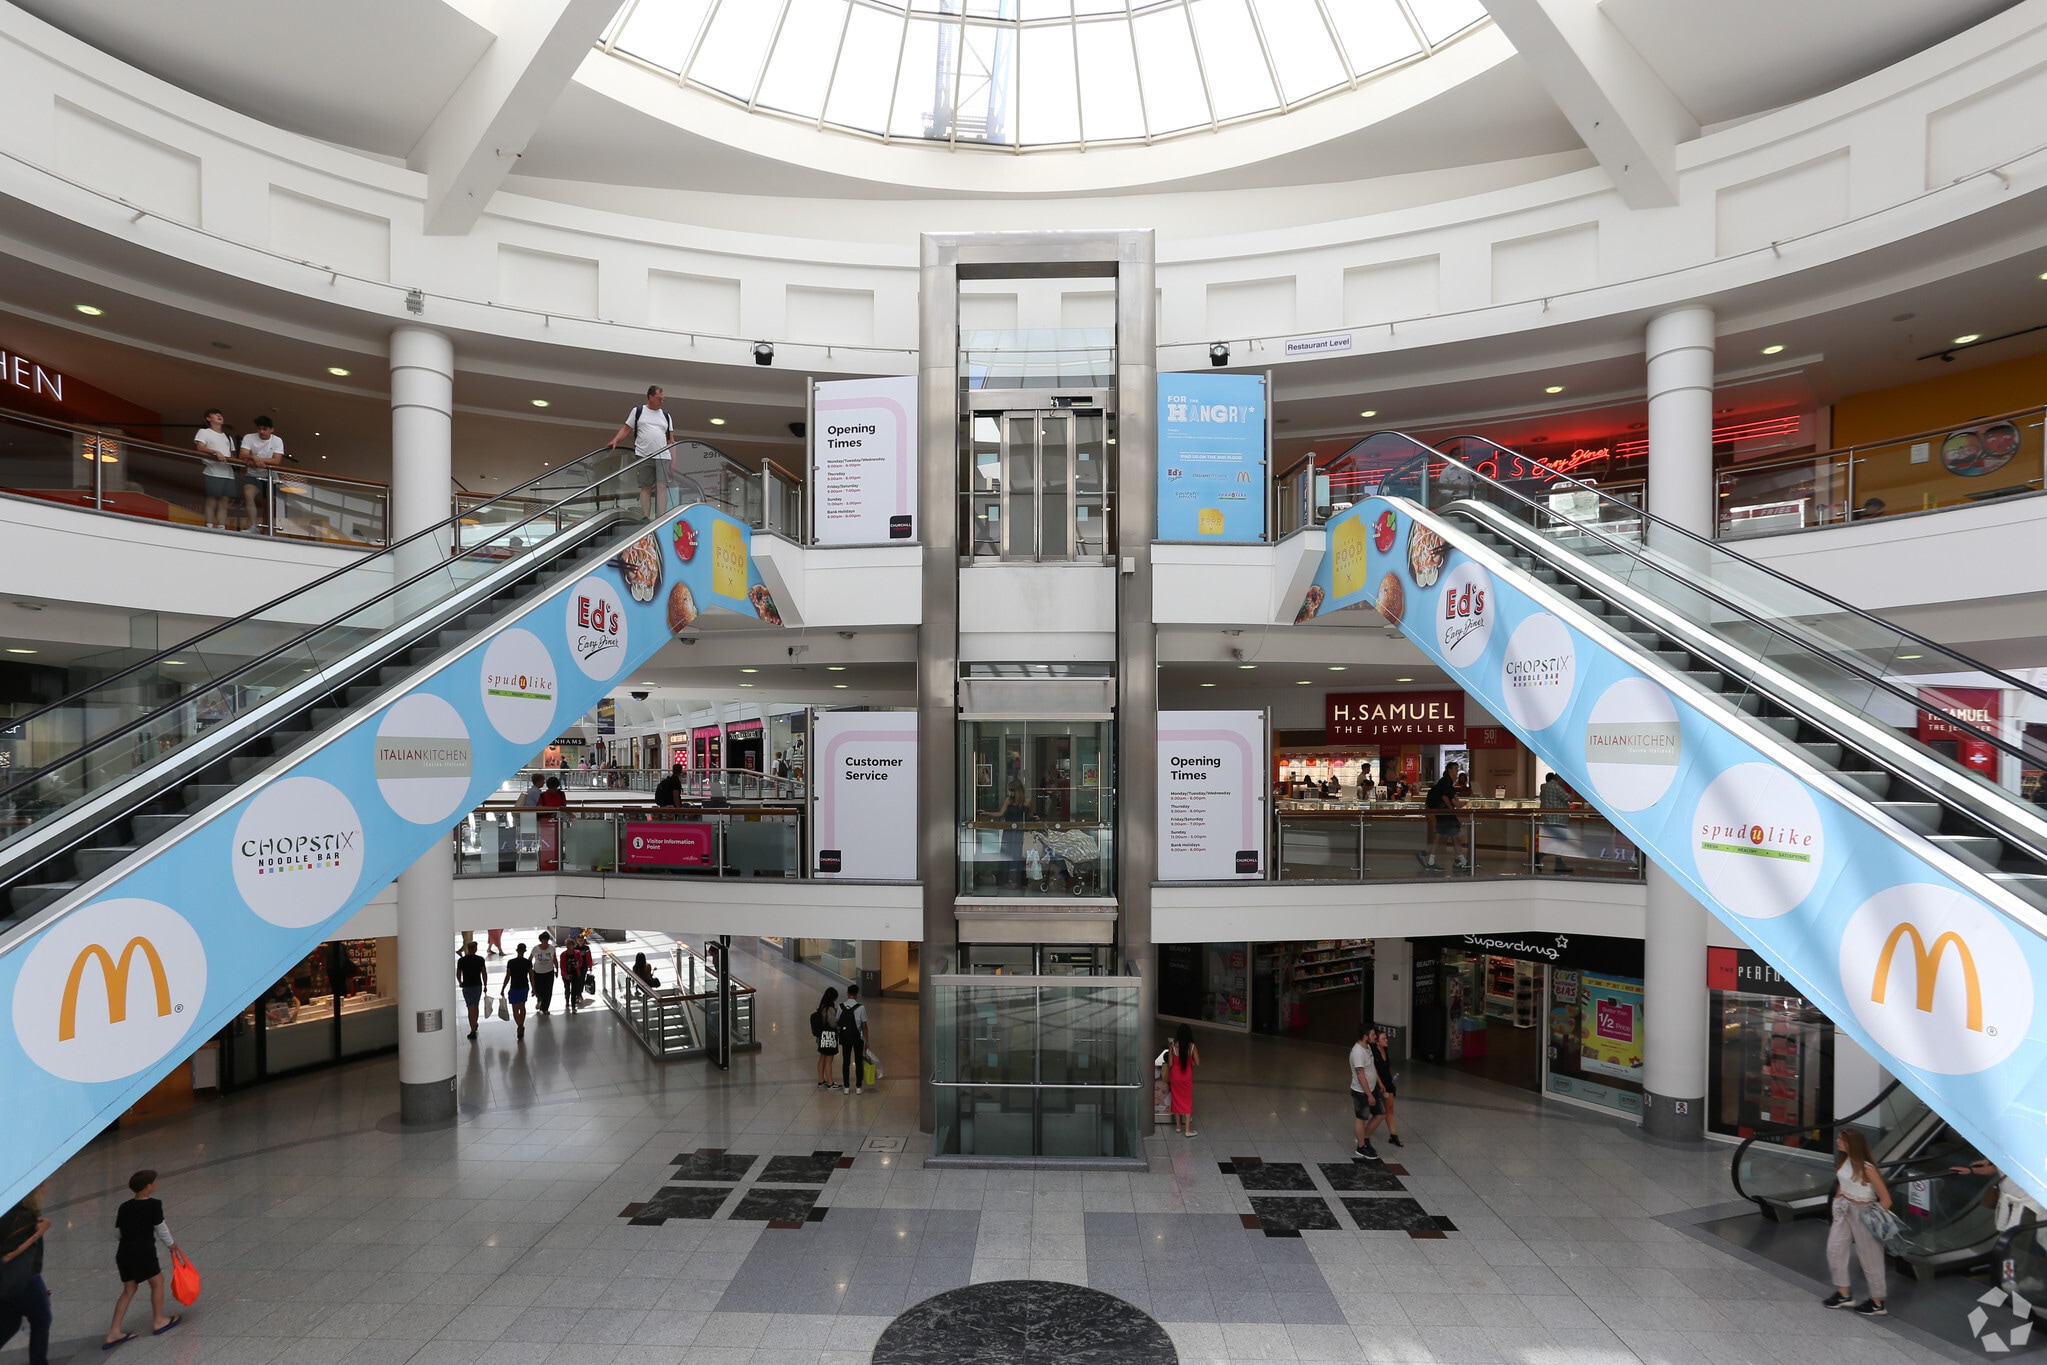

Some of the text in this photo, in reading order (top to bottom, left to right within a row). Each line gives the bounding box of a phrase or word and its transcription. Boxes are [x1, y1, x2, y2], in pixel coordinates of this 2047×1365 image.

[1288, 338, 1349, 350] Restaurant Level
[828, 423, 876, 436] Opening
[828, 438, 862, 448] Times
[1568, 448, 1609, 465] Diner
[1760, 506, 1792, 516] FRIES
[717, 546, 744, 568] FOOD
[1336, 541, 1362, 564] FOOD
[1446, 583, 1485, 620] Ed's
[578, 595, 618, 635] Ed's
[1445, 617, 1484, 644] Easy Diner
[578, 635, 619, 652] Easy Diner
[1506, 655, 1569, 675] CHOPSTIX
[488, 673, 552, 690] spudulike
[1334, 703, 1455, 721] H.SAMUEL
[1335, 724, 1455, 735] THE JEWELLER
[1590, 734, 1674, 746] ITALIANKITCHEN
[380, 749, 467, 761] ITALIANKITCHEN
[845, 757, 903, 766] Customer
[1171, 756, 1221, 768] Opening
[845, 770, 888, 780] Service
[1171, 770, 1207, 780] Times
[1702, 824, 1812, 846] spudulike
[242, 831, 354, 857] CHOPSTIX
[258, 852, 340, 866] NOODLE BAR
[1464, 934, 1559, 960] Superdrug
[1417, 960, 1435, 968] BEAUTY
[1554, 970, 1576, 980] LOVE
[1738, 965, 1788, 982] PERFU
[1555, 986, 1576, 996] BIAS
[1599, 1013, 1614, 1028] 1/2
[1616, 1023, 1631, 1032] Price
[822, 1031, 835, 1040] CULT
[821, 1040, 837, 1048] HERO
